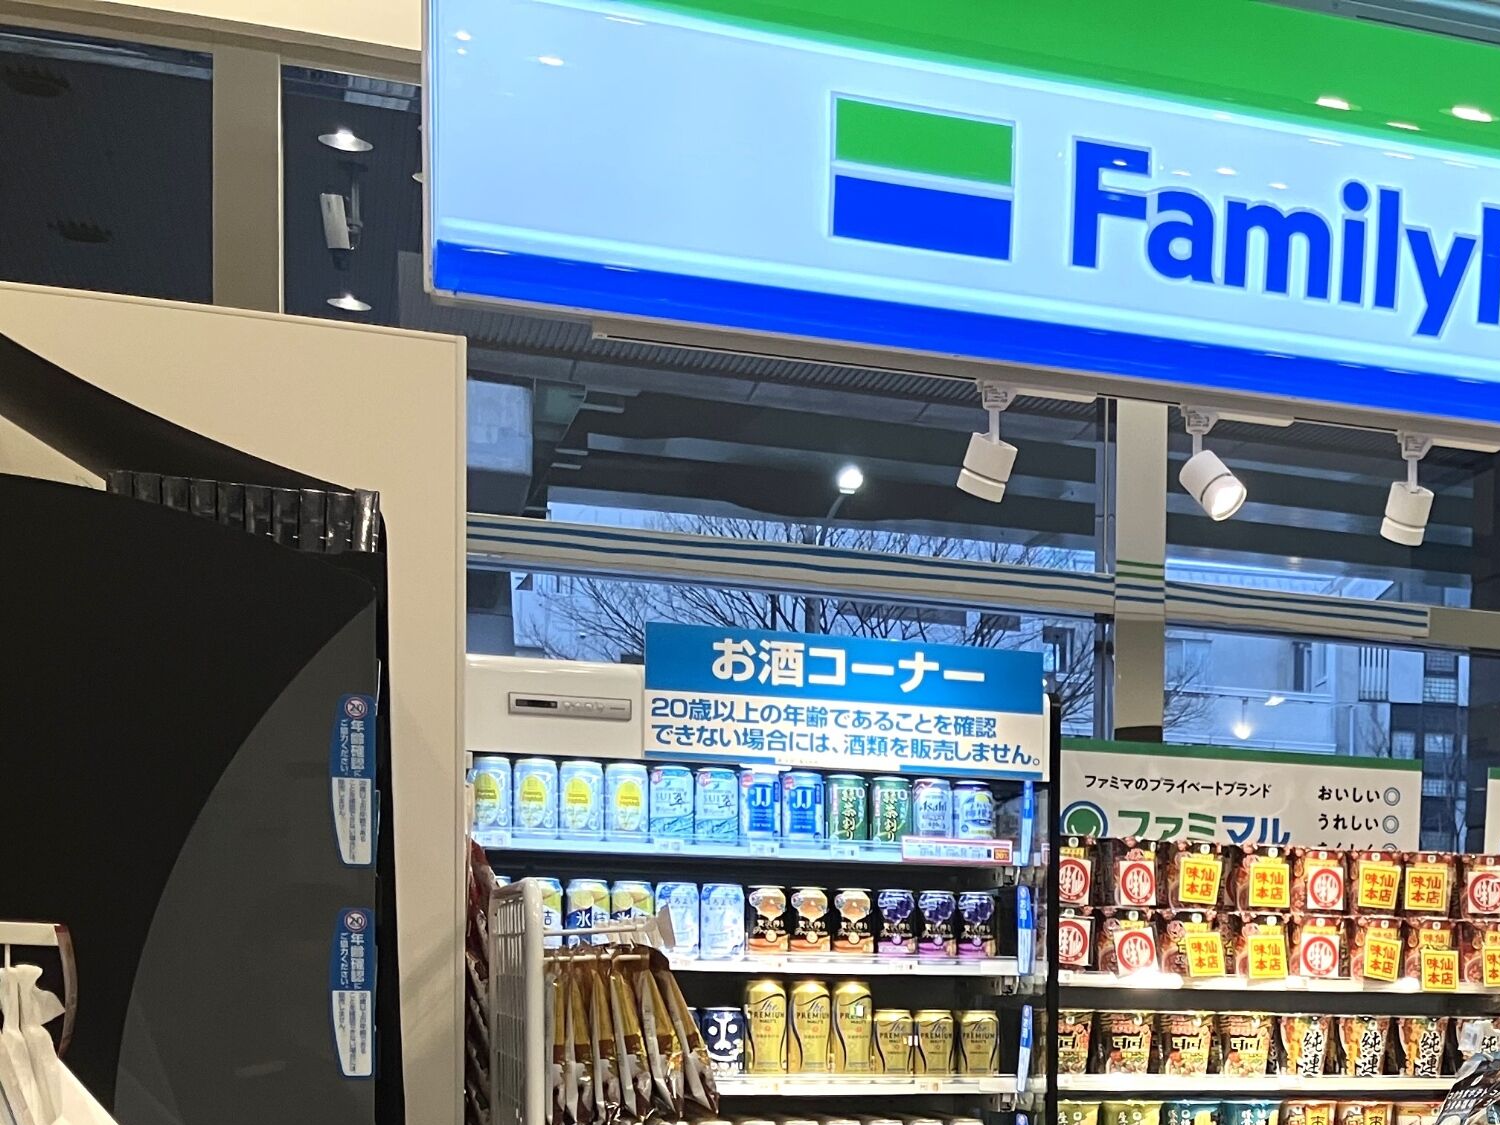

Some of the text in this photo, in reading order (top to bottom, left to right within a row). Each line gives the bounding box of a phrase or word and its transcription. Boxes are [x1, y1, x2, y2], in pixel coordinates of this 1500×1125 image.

[711, 637, 986, 693] お酒コーナー
[651, 697, 997, 738] 20歳以上の年齢であることを確認
[652, 723, 1041, 766] できない場合には、酒類を販売しません。
[751, 787, 772, 806] JJ
[1085, 774, 1273, 799] ファミマのプライベートブランド
[1317, 785, 1381, 803] おいしい
[792, 788, 813, 808] JJ
[918, 800, 948, 814] Asahi
[1118, 809, 1290, 845] ファミマル
[1317, 813, 1380, 831] うれしい
